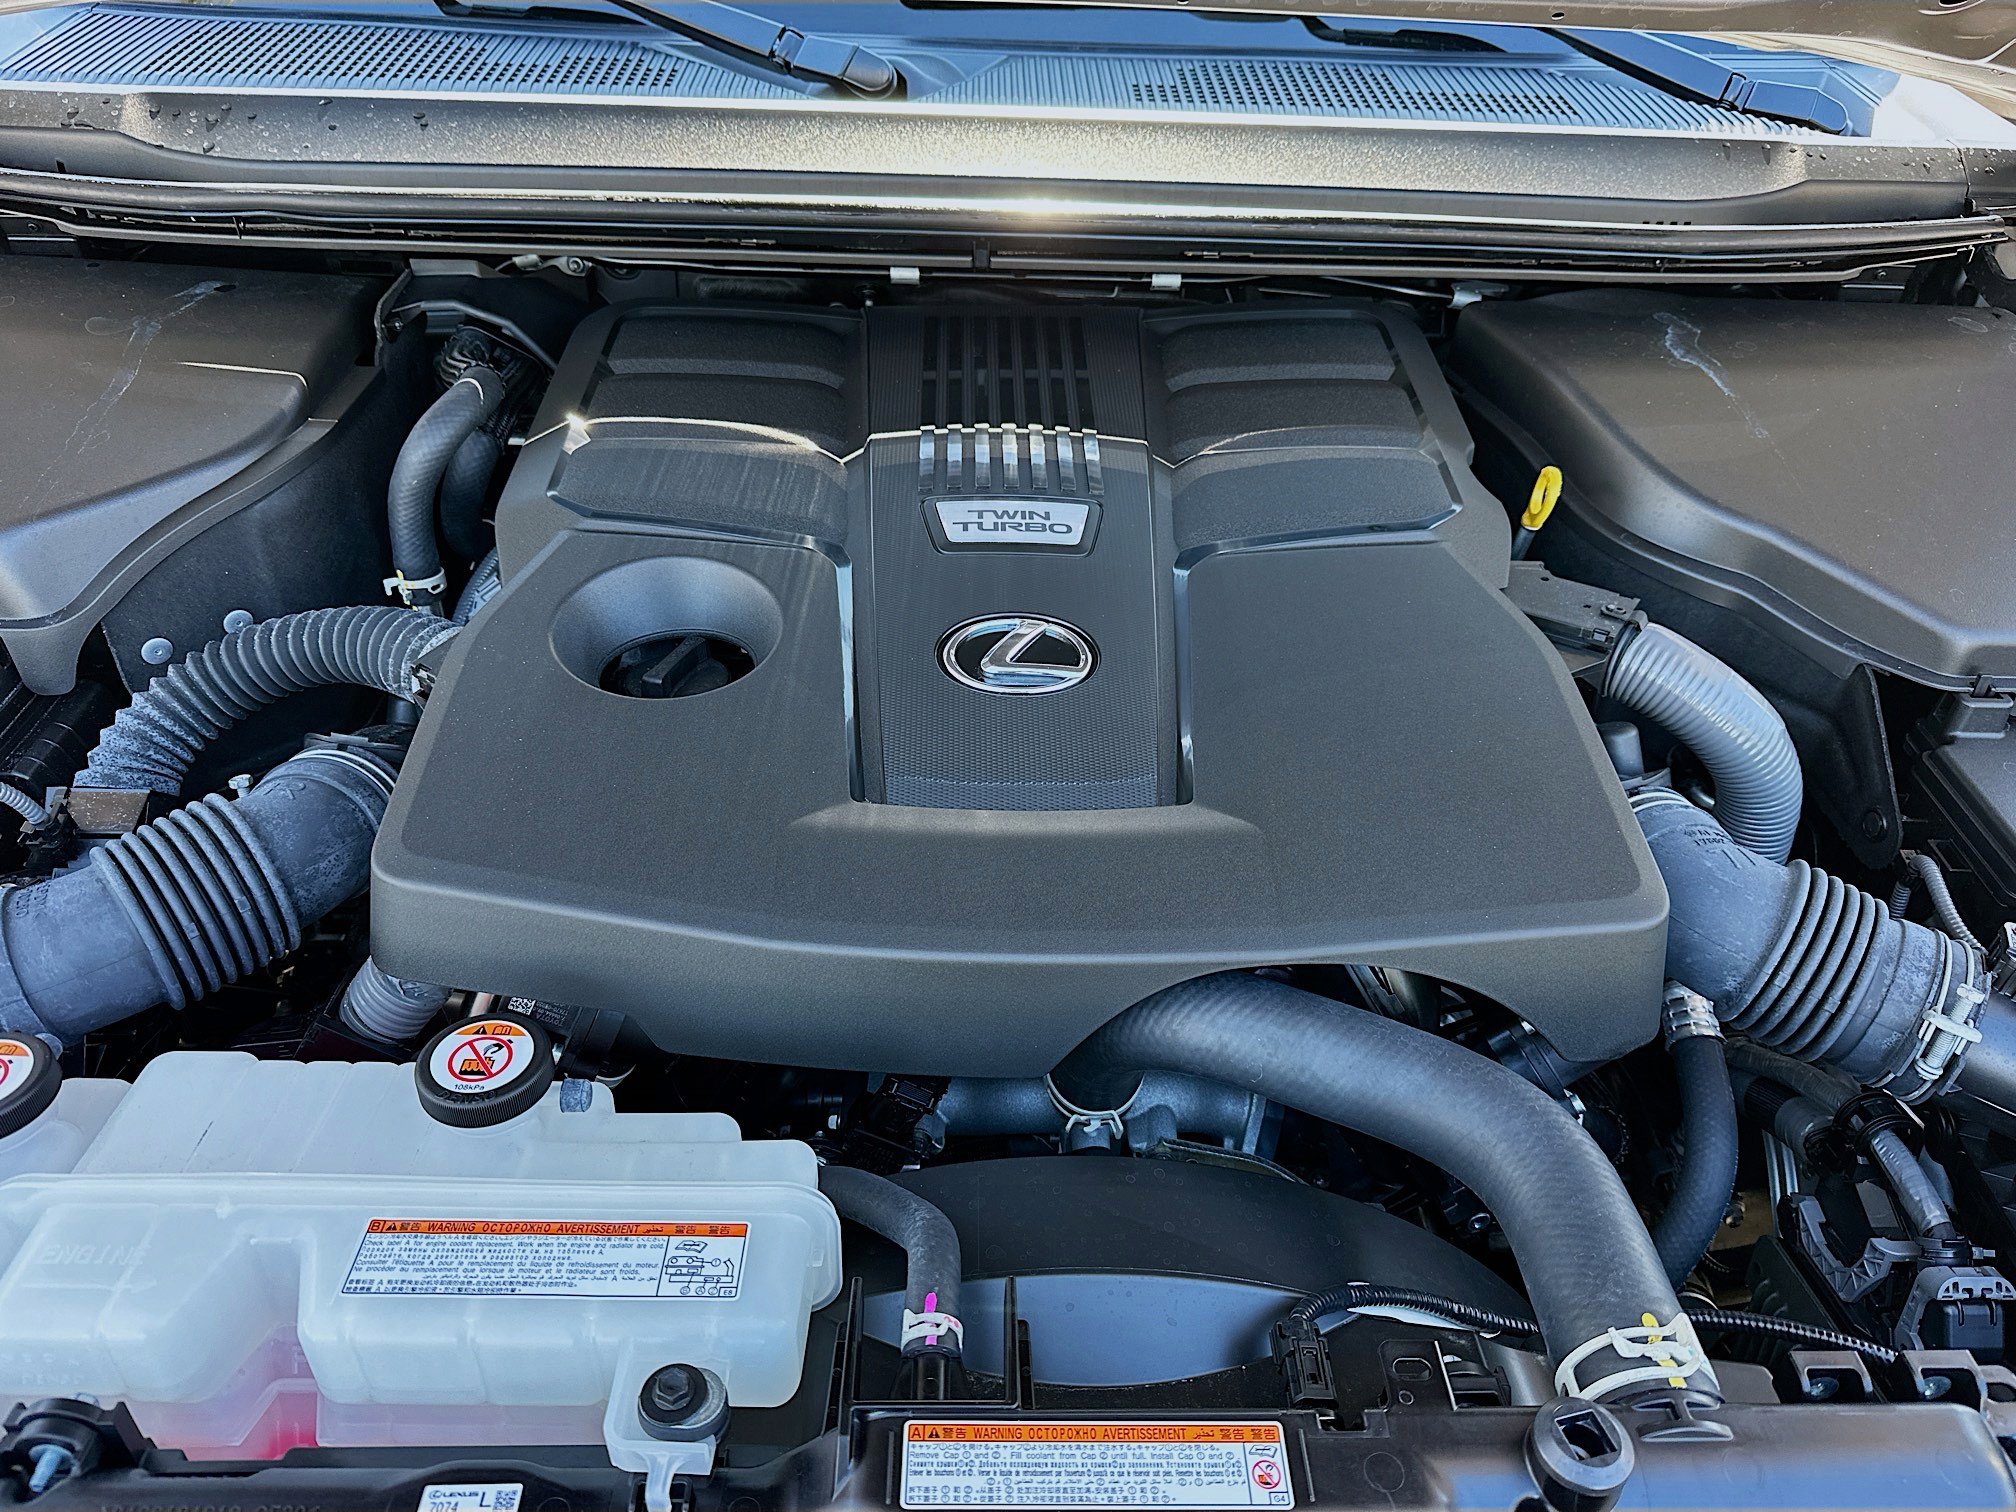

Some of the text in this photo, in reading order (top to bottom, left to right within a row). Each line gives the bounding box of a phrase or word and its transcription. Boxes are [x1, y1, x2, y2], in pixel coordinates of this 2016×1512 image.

[968, 509, 1051, 521] TWIN
[952, 522, 1073, 534] TURBO
[536, 1013, 564, 1027] TOYOTA
[371, 1222, 381, 1231] B
[427, 1223, 476, 1231] WARNING
[482, 1223, 551, 1232] ОСТОРОЖНО
[556, 1224, 641, 1234] AVERTISSEMENT
[911, 1427, 921, 1438] A
[942, 1427, 967, 1439] 警告
[973, 1427, 1022, 1439] WARNING
[1028, 1427, 1097, 1439] ОСТОРОЖНО
[1102, 1428, 1187, 1440] AVERTISSEMENT
[1219, 1428, 1245, 1440] 警告
[1250, 1428, 1275, 1440] 警告
[910, 1451, 939, 1459] Remove
[943, 1451, 959, 1459] Cap
[1011, 1451, 1022, 1459] Fill
[1080, 1452, 1097, 1460] Cap
[1178, 1452, 1194, 1460] Cap
[479, 1492, 491, 1507] L
[1274, 1495, 1286, 1503] G4
